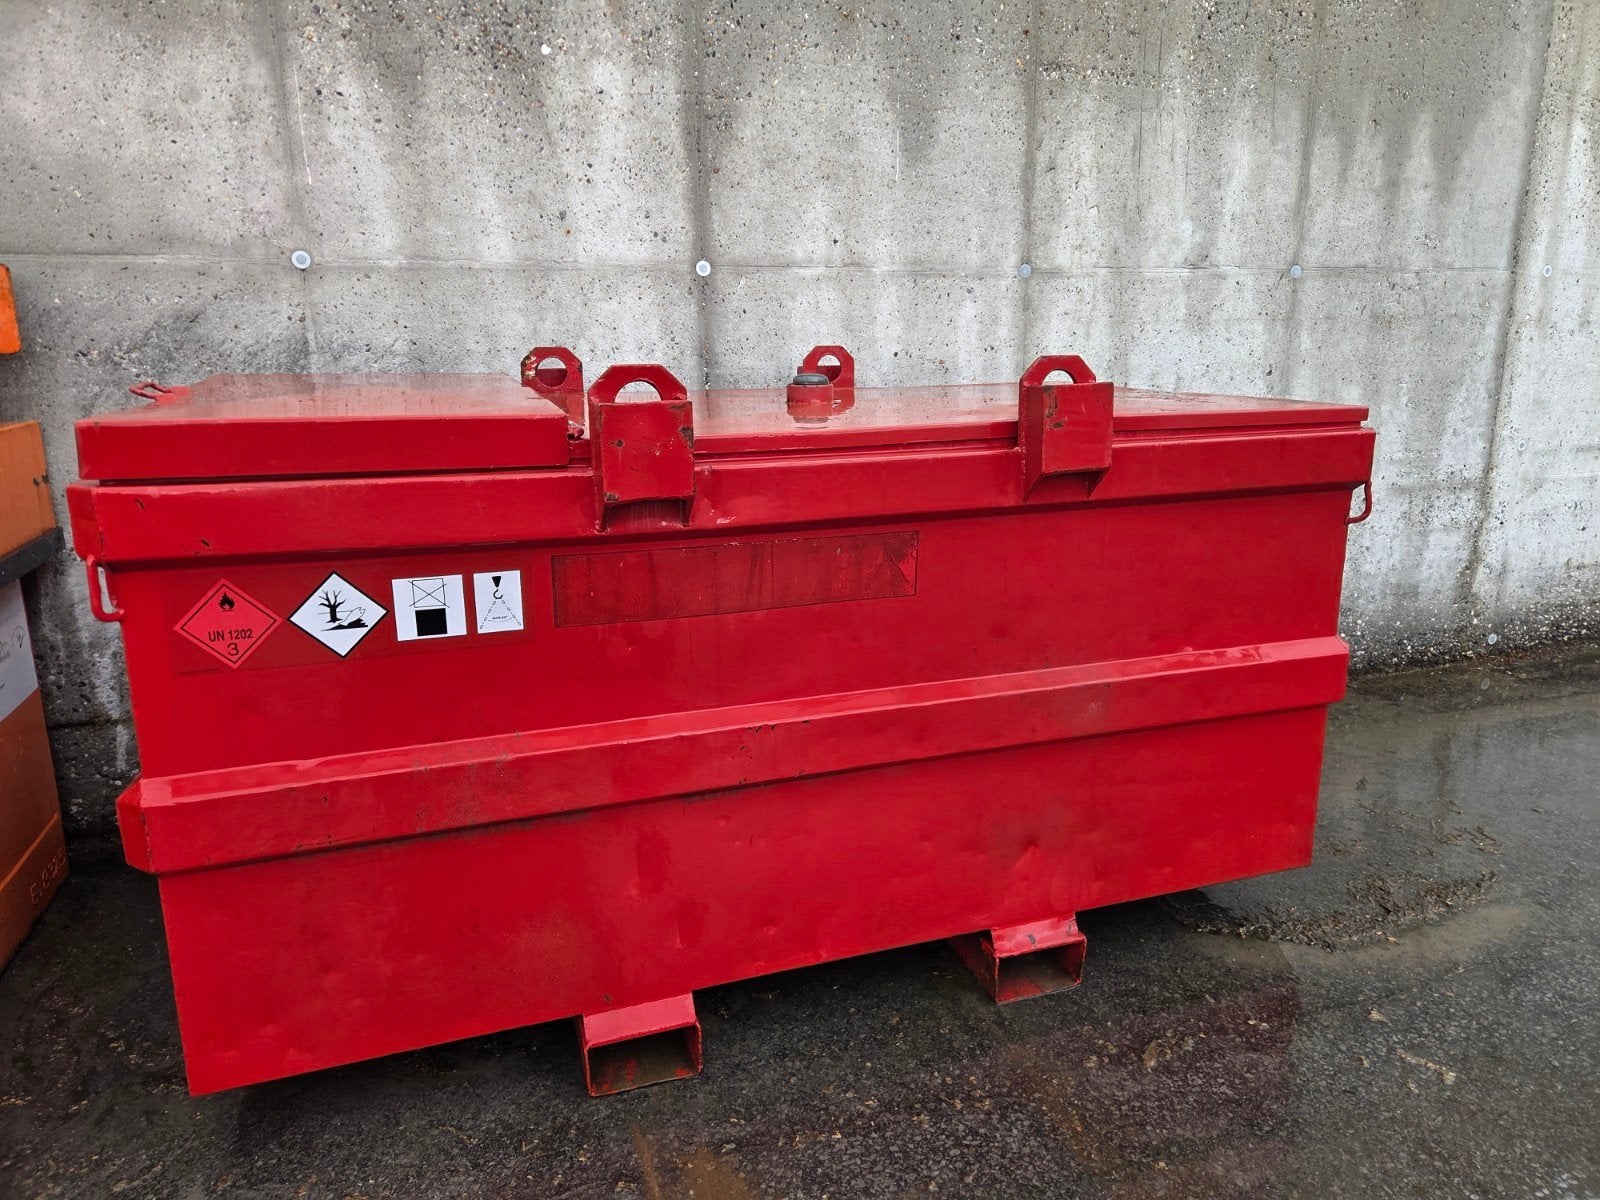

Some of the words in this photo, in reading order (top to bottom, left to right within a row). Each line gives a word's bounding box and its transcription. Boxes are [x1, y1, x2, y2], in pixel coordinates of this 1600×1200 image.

[209, 630, 225, 642] UN
[228, 628, 253, 640] 1202
[226, 642, 239, 656] 3
